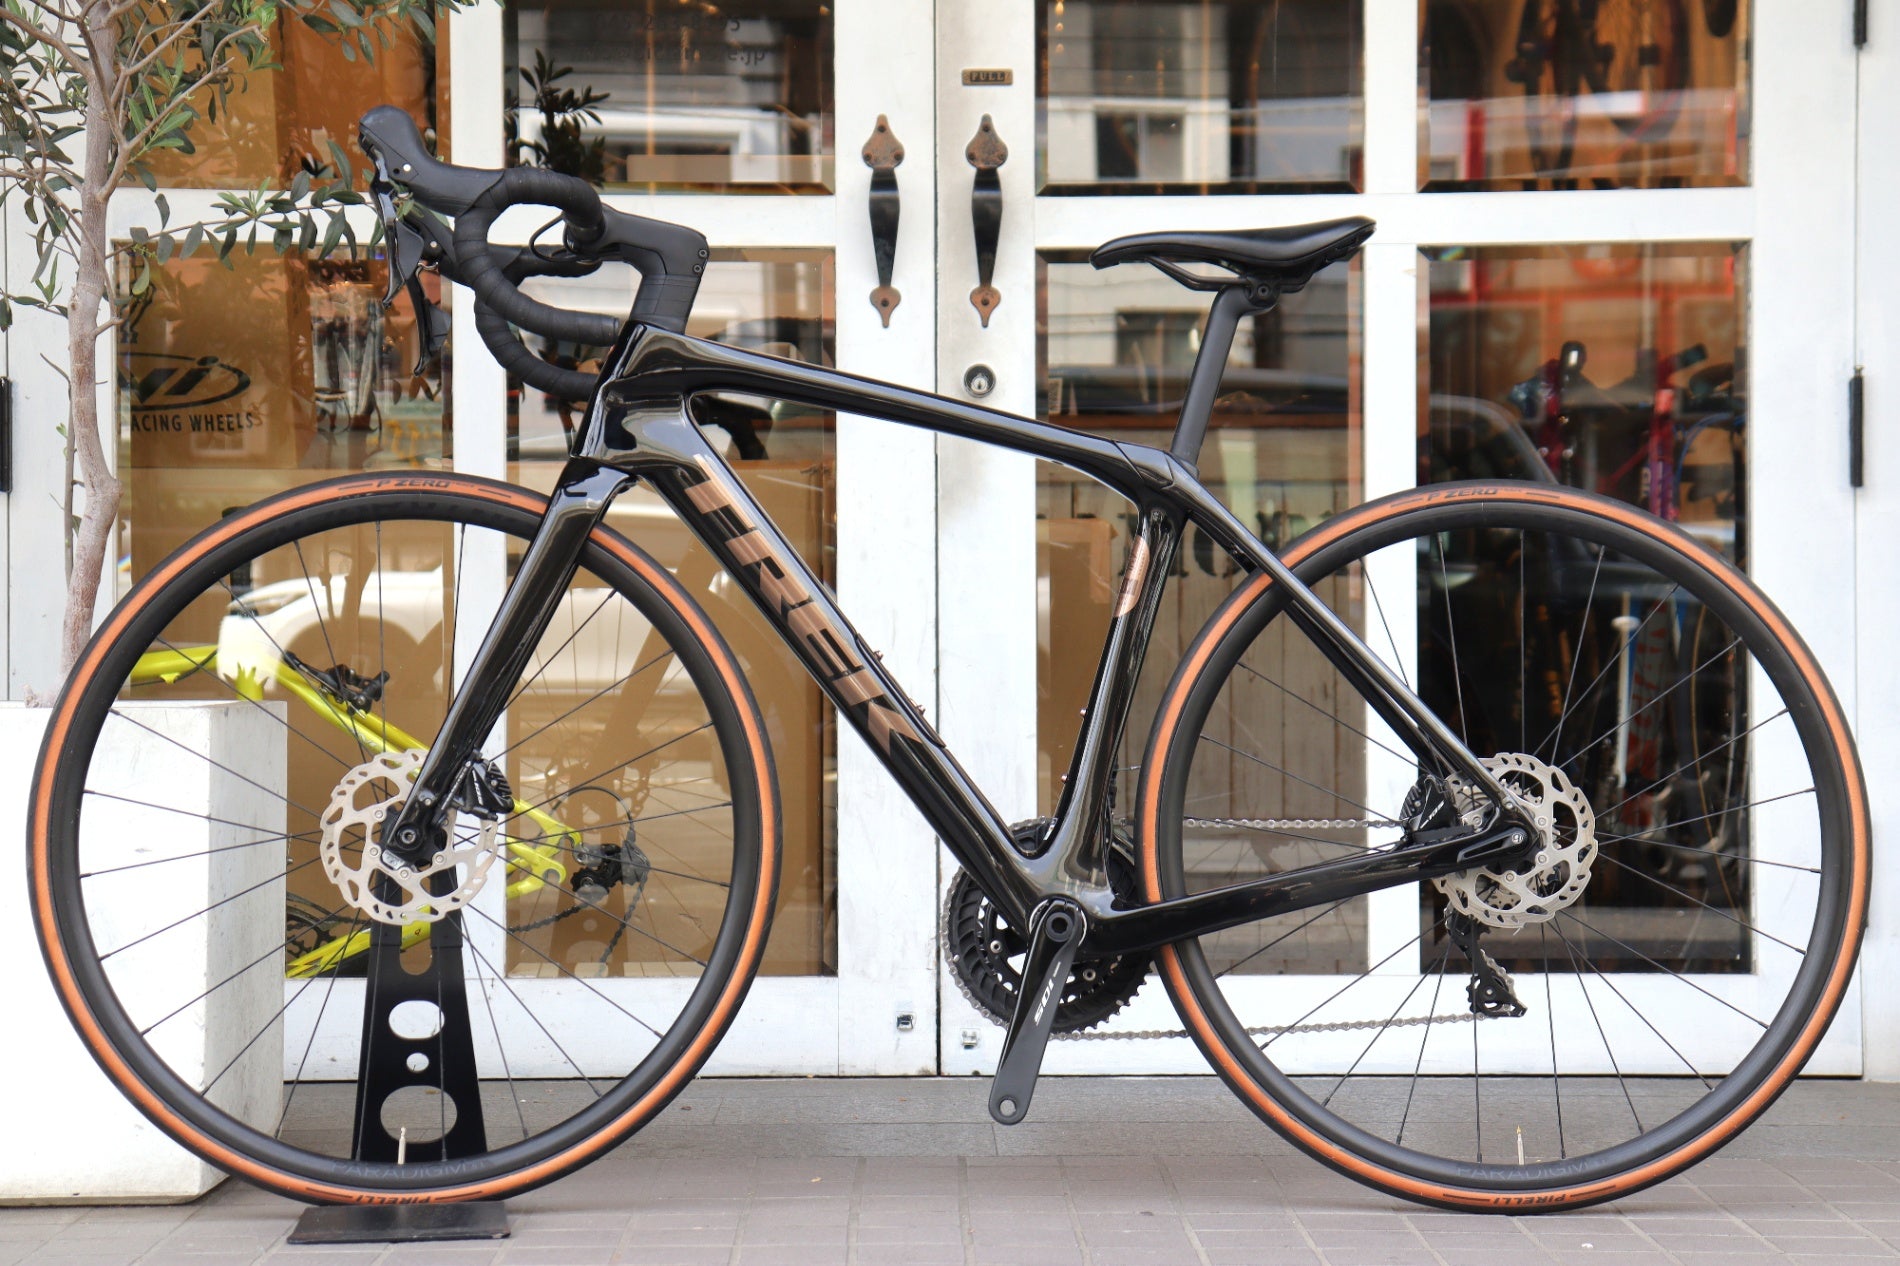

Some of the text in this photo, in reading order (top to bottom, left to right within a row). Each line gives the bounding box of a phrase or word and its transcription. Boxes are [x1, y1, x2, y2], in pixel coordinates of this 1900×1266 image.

[130, 412, 254, 432] ACING WHEELS
[394, 479, 450, 489] ZERO
[1444, 487, 1499, 499] ZERO
[685, 453, 923, 753] TREK
[355, 1194, 432, 1205] PIRELLI
[1493, 1193, 1567, 1206] PIRELLI
